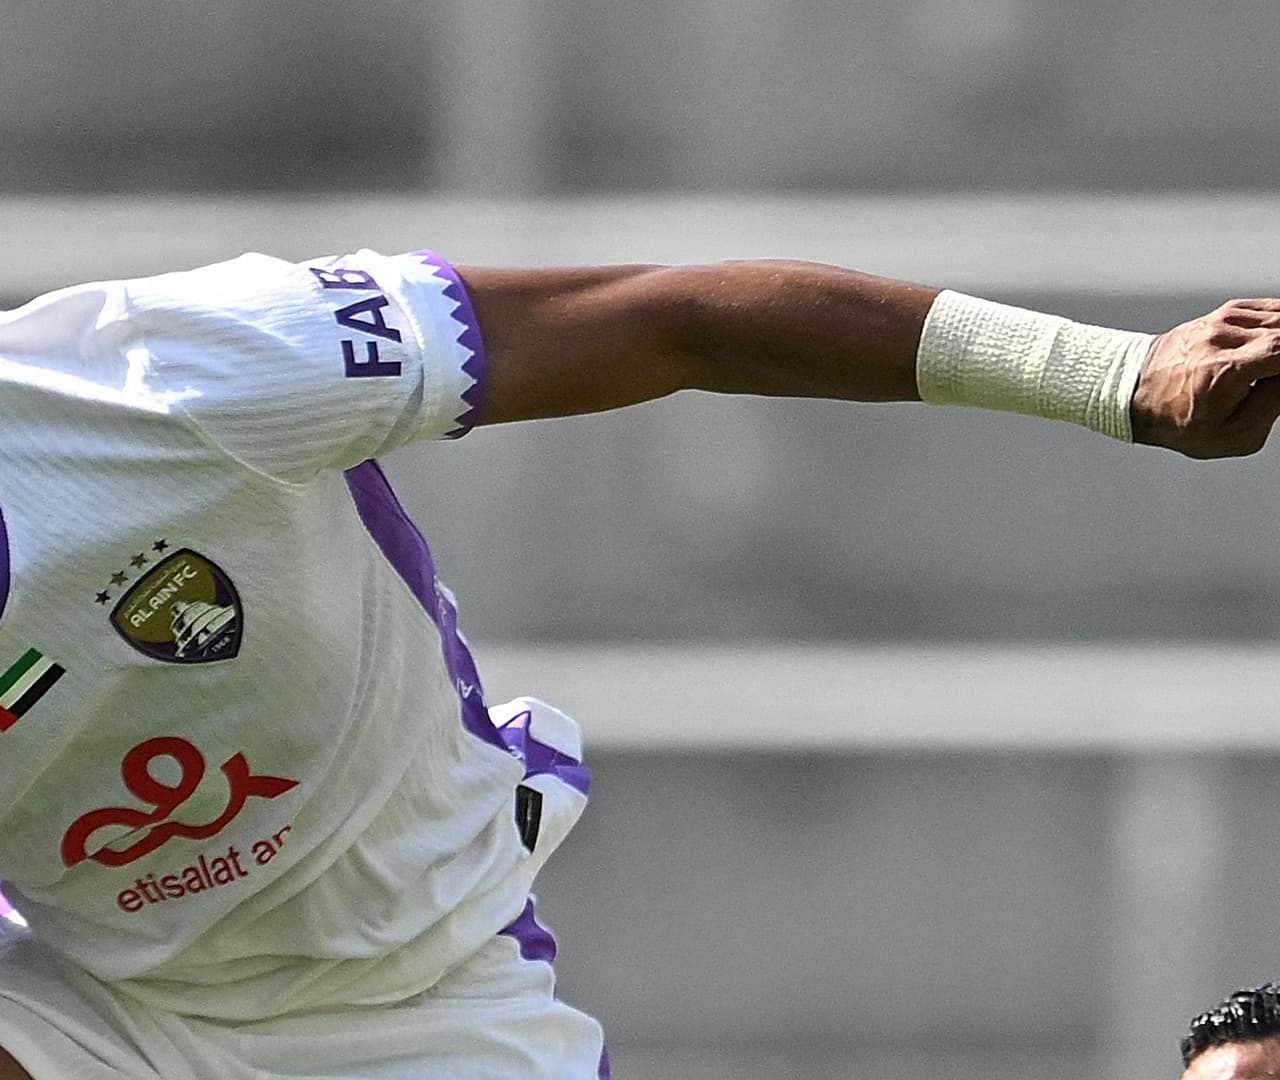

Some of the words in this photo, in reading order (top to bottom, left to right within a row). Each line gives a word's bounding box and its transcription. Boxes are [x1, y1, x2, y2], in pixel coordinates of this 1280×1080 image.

[130, 609, 155, 628] AL
[148, 582, 179, 610] AIN
[172, 565, 198, 587] FC
[117, 846, 249, 913] etisalat
